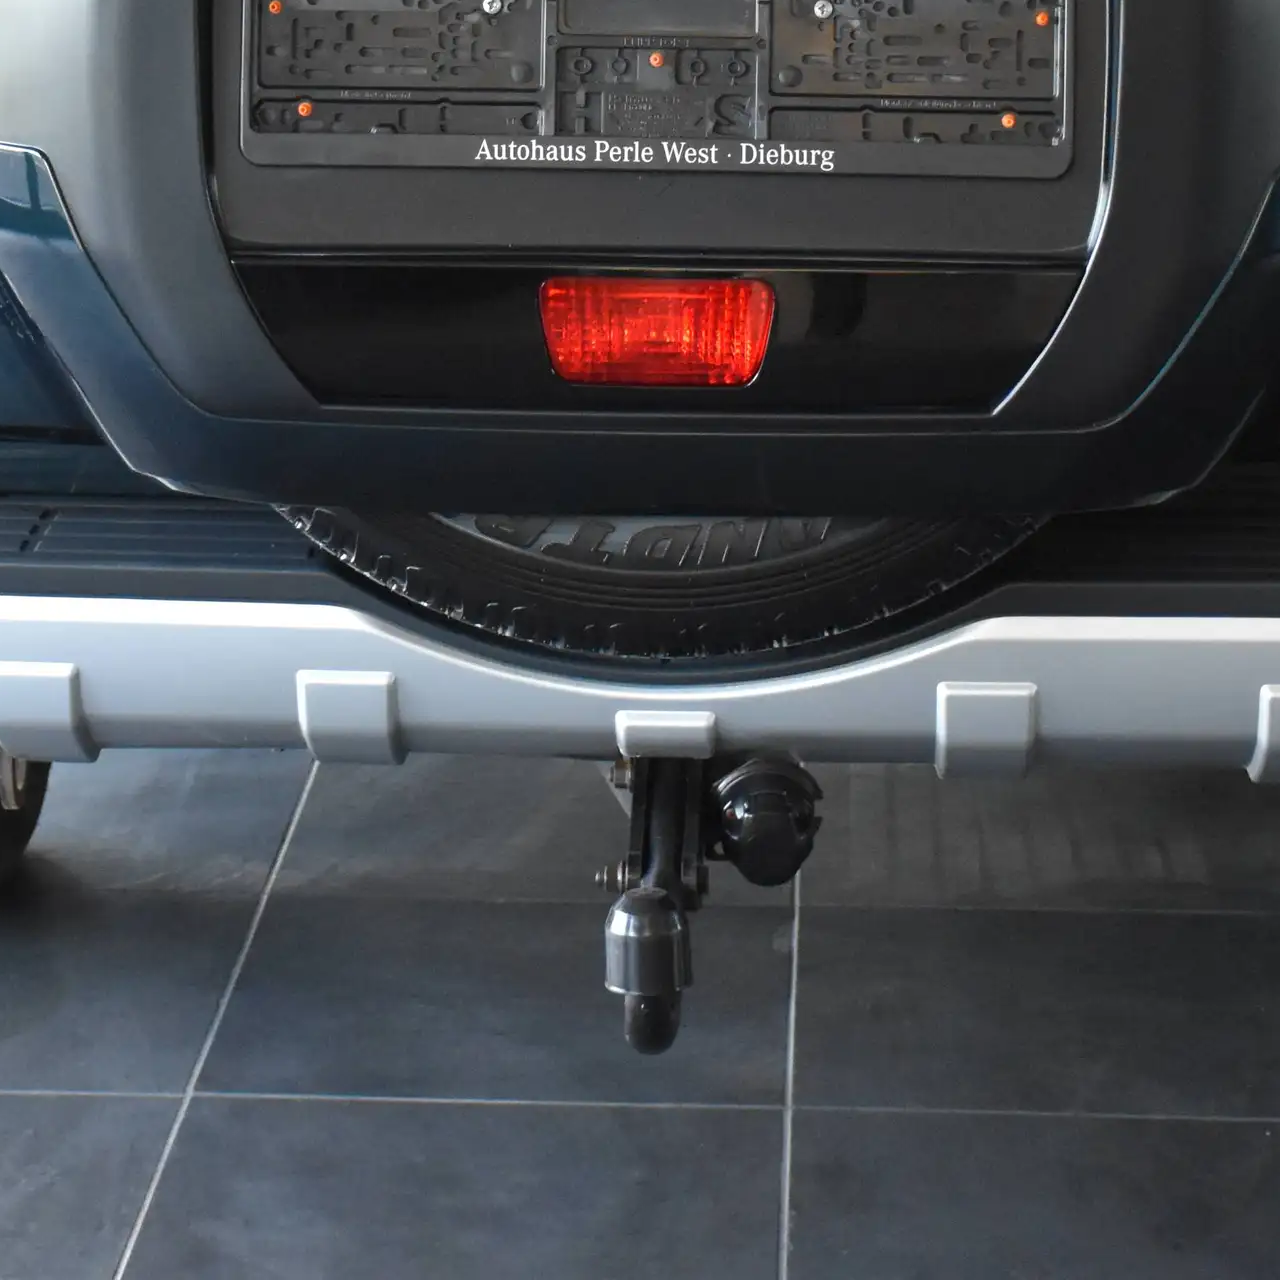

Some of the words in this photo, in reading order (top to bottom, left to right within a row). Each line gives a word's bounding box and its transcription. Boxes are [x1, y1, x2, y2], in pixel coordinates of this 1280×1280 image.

[474, 138, 587, 162] Autohaus
[593, 140, 654, 163] Perle
[661, 141, 719, 165] West
[739, 143, 835, 171] Dieburg
